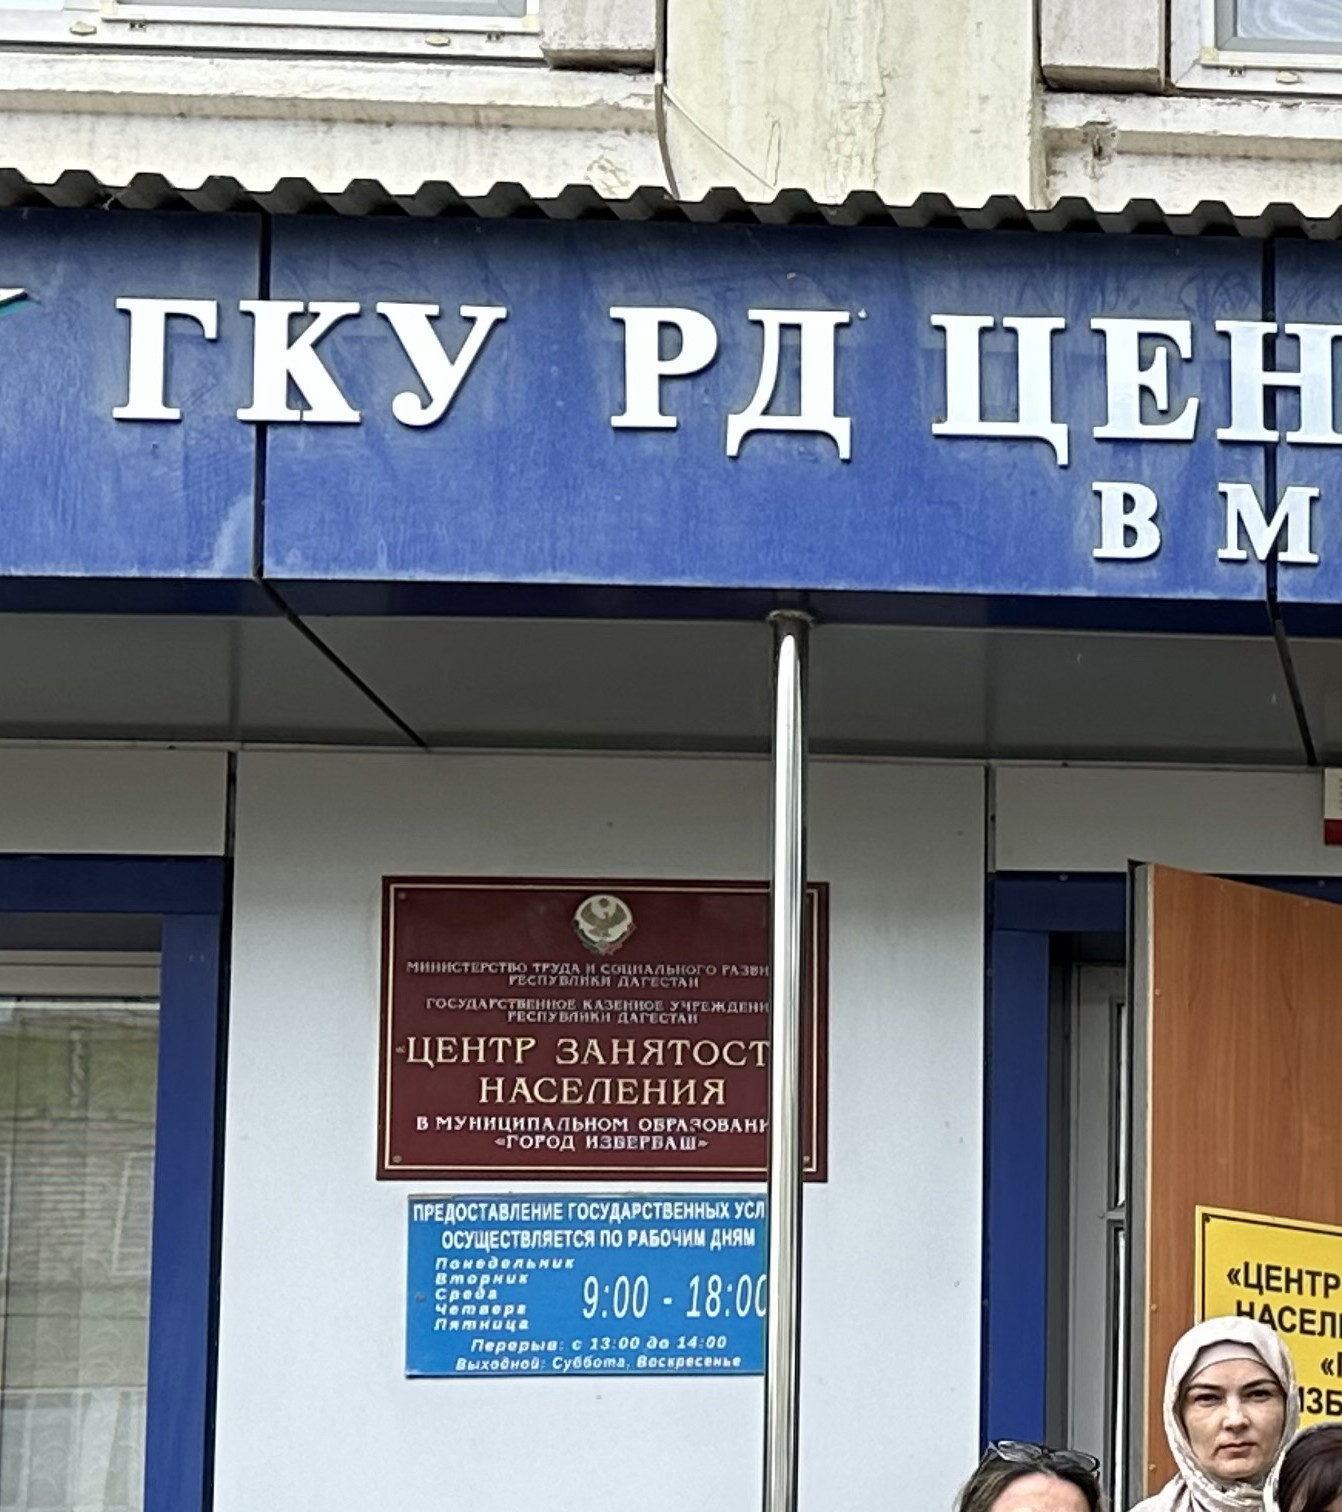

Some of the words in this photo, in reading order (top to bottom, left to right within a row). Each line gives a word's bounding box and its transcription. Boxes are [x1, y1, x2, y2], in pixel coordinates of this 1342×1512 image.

[112, 296, 508, 428] ГКУ
[608, 305, 852, 461] РД
[1091, 480, 1161, 561] В
[406, 961, 528, 974] МИНИСТЕРСТВО
[532, 962, 580, 975] ТРУДА
[585, 963, 596, 975] И
[600, 963, 717, 976] СОЦИАЛЬНОГО
[722, 964, 770, 977] РАЗВИ
[509, 974, 611, 987] РЕСПУБЛИКИ
[617, 976, 699, 988] ДАГЕСТАН
[426, 997, 577, 1011] ГОСУДАРСТВЕННОЕ
[583, 999, 664, 1012] КАЗЕННОЕ
[670, 1000, 770, 1014] УЧРЕЖДЕНИ
[507, 1010, 611, 1023] РЕСПУБЛИКИ
[617, 1012, 698, 1025] ДАГЕСТАН
[555, 1037, 770, 1067] ЗАНЯТОСТ
[478, 1076, 726, 1106] НАСЕЛЕНИЯ
[416, 1115, 429, 1131] В
[435, 1115, 629, 1133] МУНИЦИПАЛЬНОМ
[638, 1117, 770, 1134] ОБРАЗОВАНИ
[413, 1202, 563, 1225] ПРЕДОСТАВЛЕНИЕ
[568, 1201, 730, 1225] ГОСУДАРСТВЕННЫХ
[734, 1201, 766, 1220] УСЛ
[441, 1229, 596, 1253] ОСУЩЕСТВЛЯЕТСЯ
[600, 1229, 623, 1248] ПО
[627, 1228, 706, 1248] РАБОЧИМ
[710, 1227, 756, 1252] ДНЯМ
[435, 1272, 529, 1288] Вторник
[1226, 1261, 1341, 1296] «ЦЕНТР
[435, 1287, 498, 1303] Среда
[582, 1275, 650, 1319] 9:00
[435, 1303, 527, 1318] Четверг
[433, 1317, 530, 1332] Пятница
[470, 1338, 564, 1354] Перерыв:
[589, 1337, 641, 1351] 13:00
[646, 1335, 670, 1350] до
[677, 1335, 728, 1350] 14:00
[552, 1355, 631, 1372] Суббота,
[636, 1355, 742, 1370] Воскресенье
